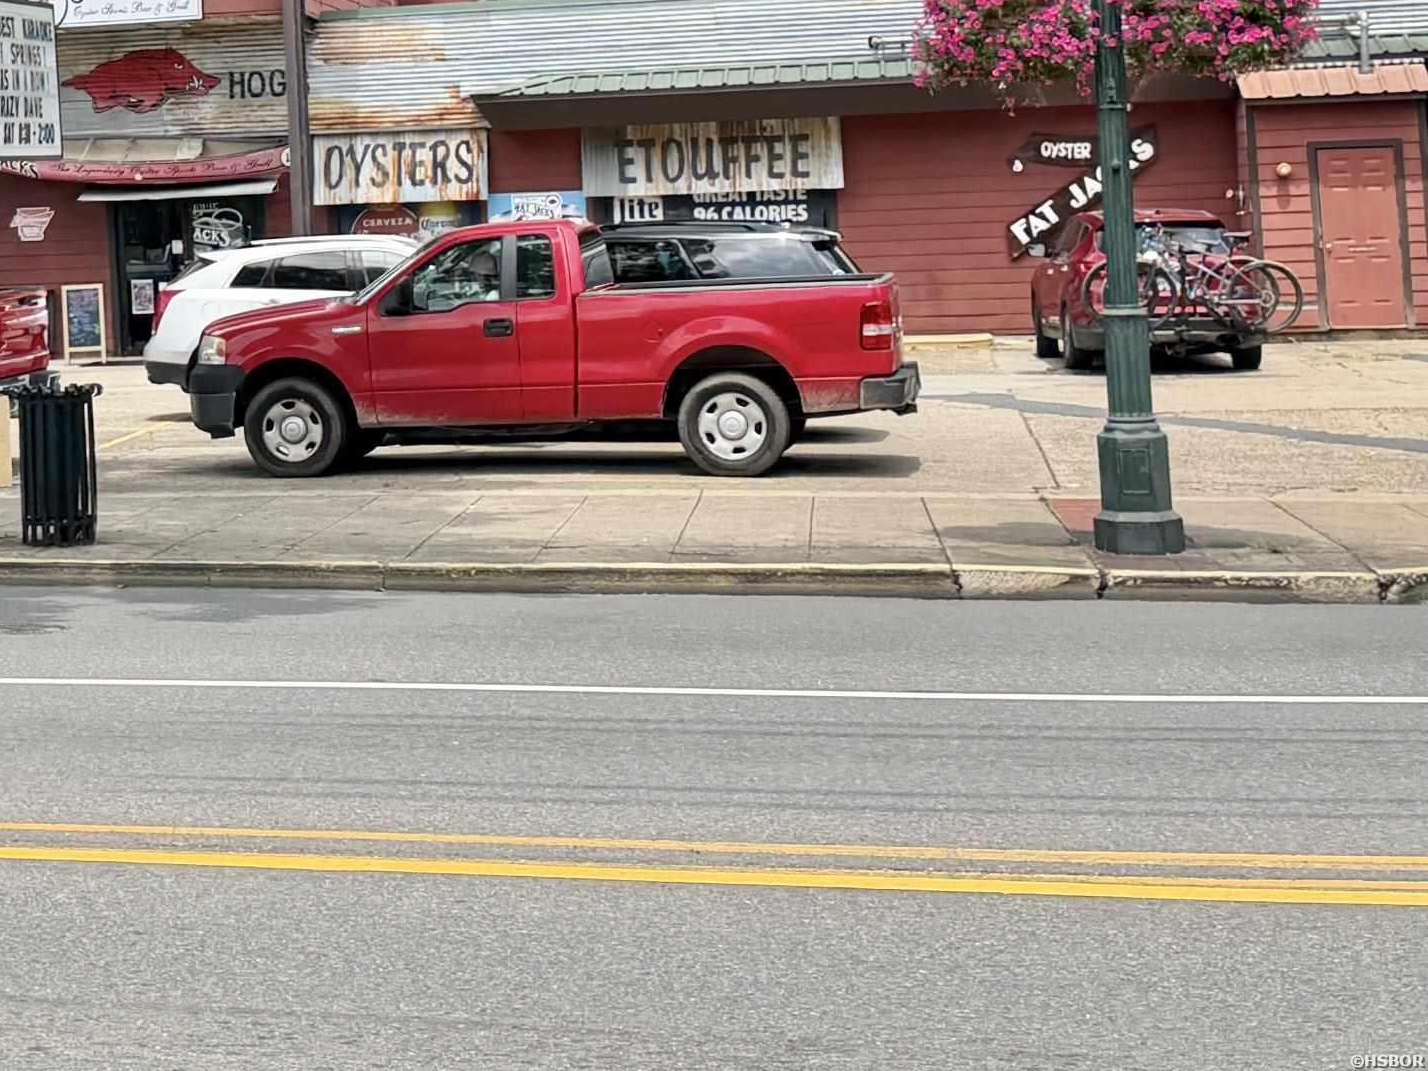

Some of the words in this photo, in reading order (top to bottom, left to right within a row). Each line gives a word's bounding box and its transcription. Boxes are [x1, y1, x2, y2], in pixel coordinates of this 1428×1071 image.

[12, 68, 21, 90] IN
[228, 69, 287, 100] HOG
[24, 96, 44, 118] DAVE
[3, 123, 15, 145] SAT
[615, 133, 811, 184] ETOUFFEE
[1040, 142, 1092, 160] OYSTER
[323, 139, 474, 190] OYSTERS
[693, 190, 749, 204] GREAT
[755, 189, 808, 201] TASTE
[1009, 199, 1060, 246] FAT
[1068, 138, 1155, 209] JAS
[362, 217, 413, 227] CERVEZA
[693, 206, 719, 220] 96
[721, 204, 809, 222] CALORIES
